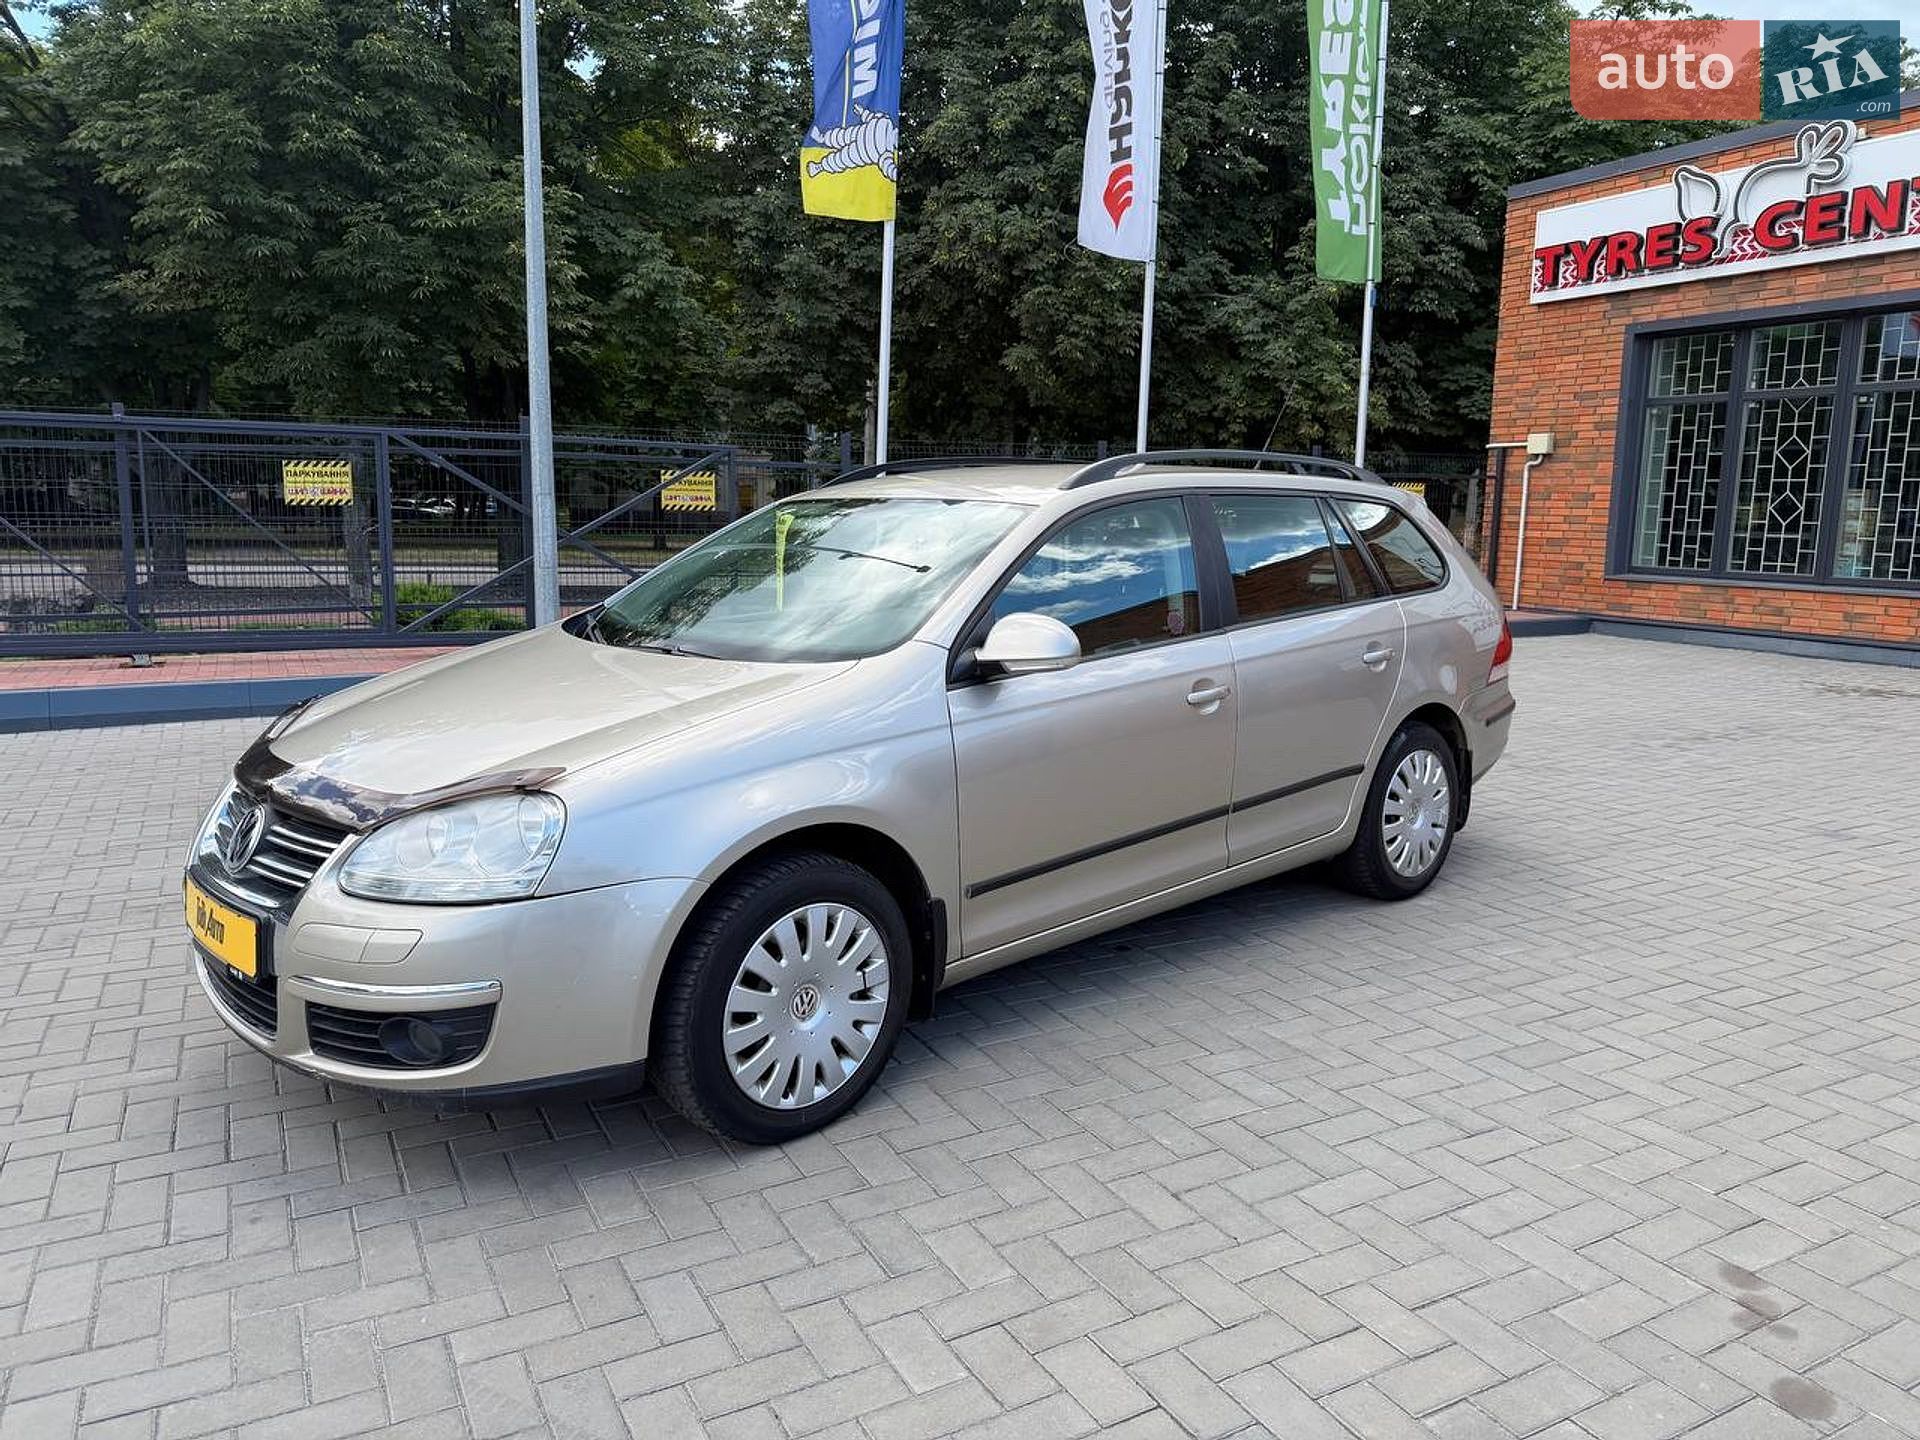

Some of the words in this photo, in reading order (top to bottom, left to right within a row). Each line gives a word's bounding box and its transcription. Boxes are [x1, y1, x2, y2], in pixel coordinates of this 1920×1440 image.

[1535, 216, 1726, 288] TYRES
[1753, 175, 1920, 253] CEN
[285, 469, 349, 478] ПАРКУВАННЯ
